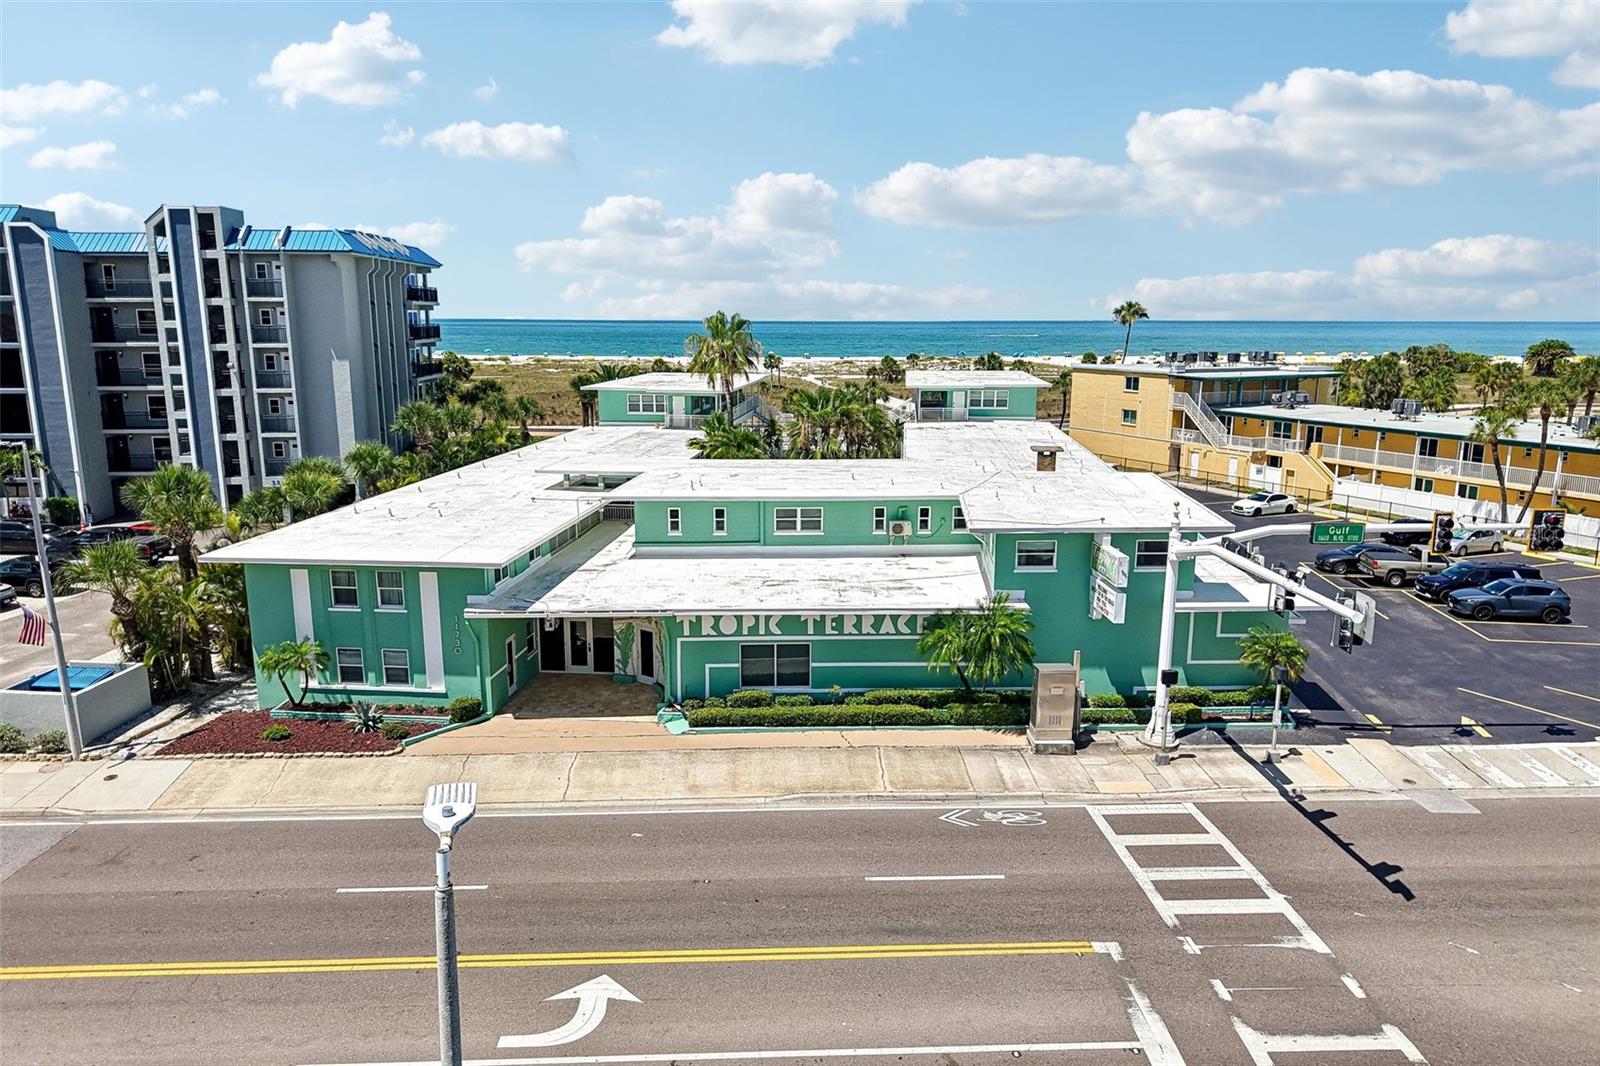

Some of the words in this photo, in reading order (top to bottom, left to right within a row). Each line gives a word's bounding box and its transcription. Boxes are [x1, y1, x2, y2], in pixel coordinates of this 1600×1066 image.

[1328, 526, 1350, 534] Gulf
[676, 615, 783, 636] TROPIC
[800, 614, 930, 635] TERRACE
